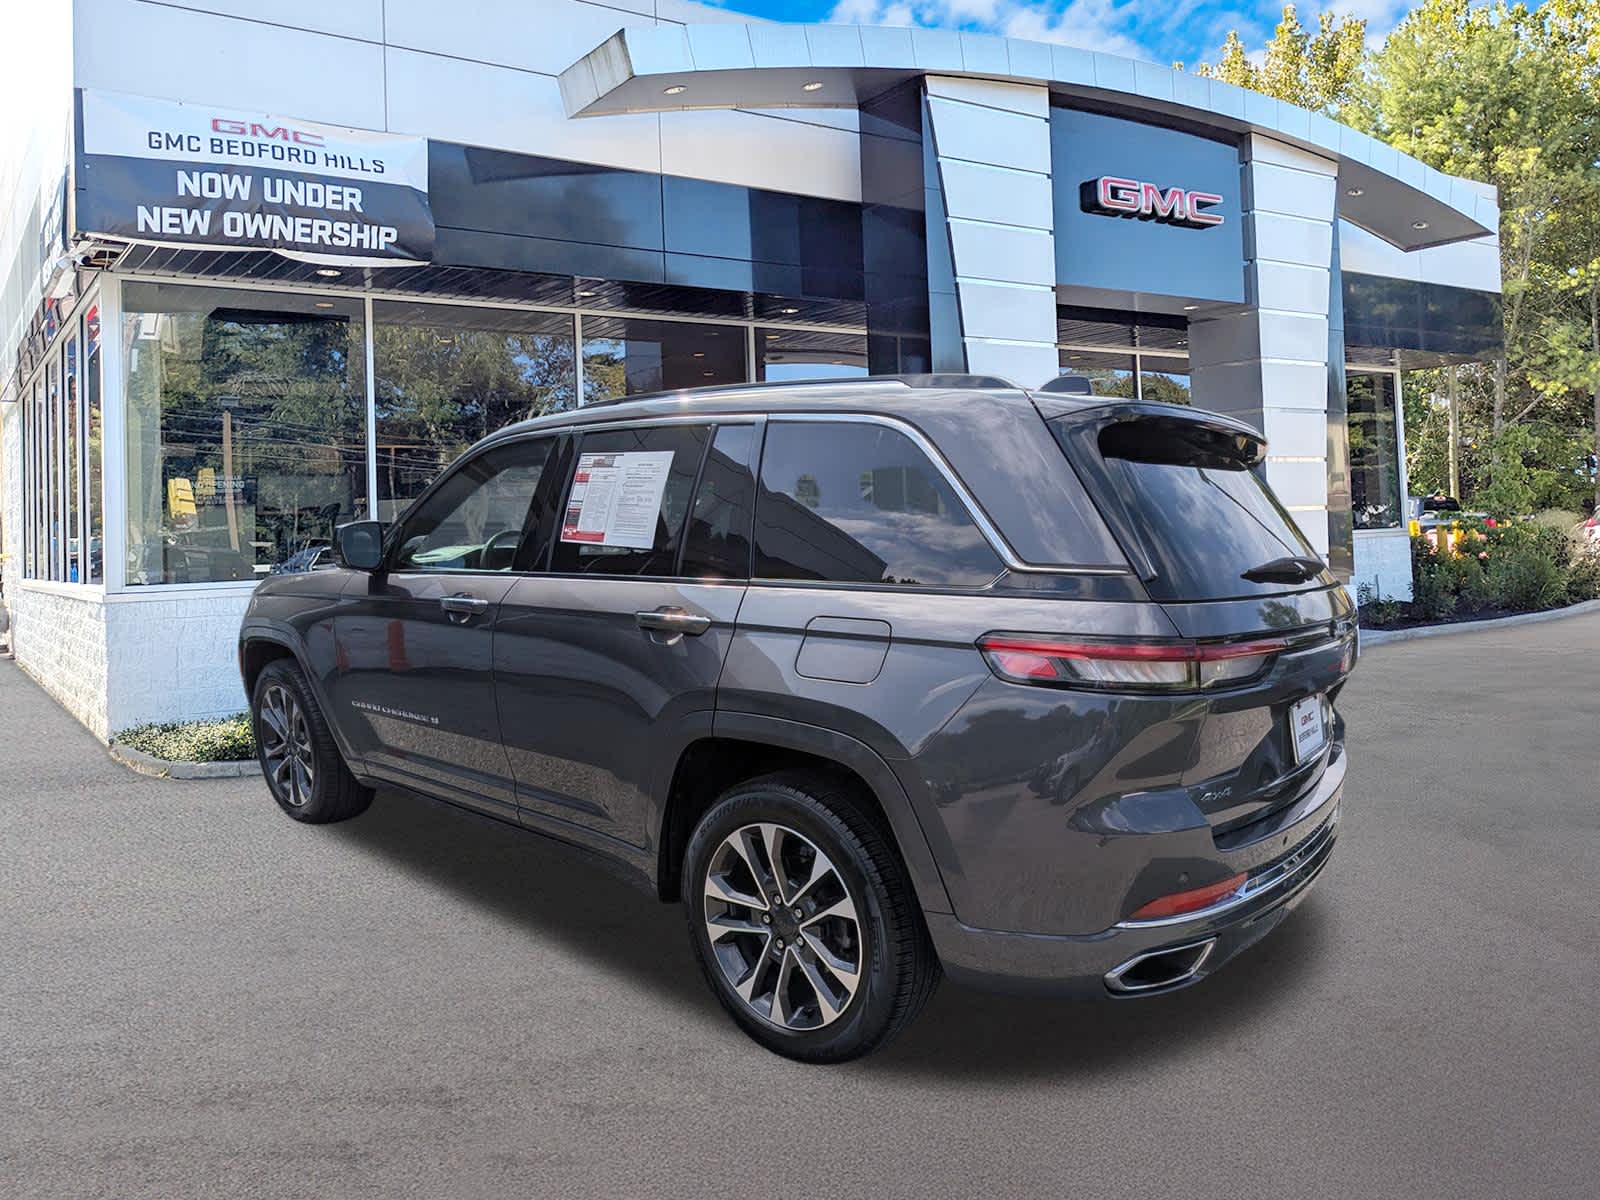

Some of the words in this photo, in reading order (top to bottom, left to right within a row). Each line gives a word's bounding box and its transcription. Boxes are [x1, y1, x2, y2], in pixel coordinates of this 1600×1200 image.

[147, 131, 201, 153] GMC
[209, 137, 317, 166] BEDFORD
[323, 152, 386, 175] HILLS
[211, 118, 326, 148] GMC
[177, 170, 252, 201] NOW
[263, 177, 364, 213] UNDER
[1097, 175, 1225, 225] GMC
[137, 206, 212, 236] NEW
[222, 211, 399, 251] OWNERSHIP
